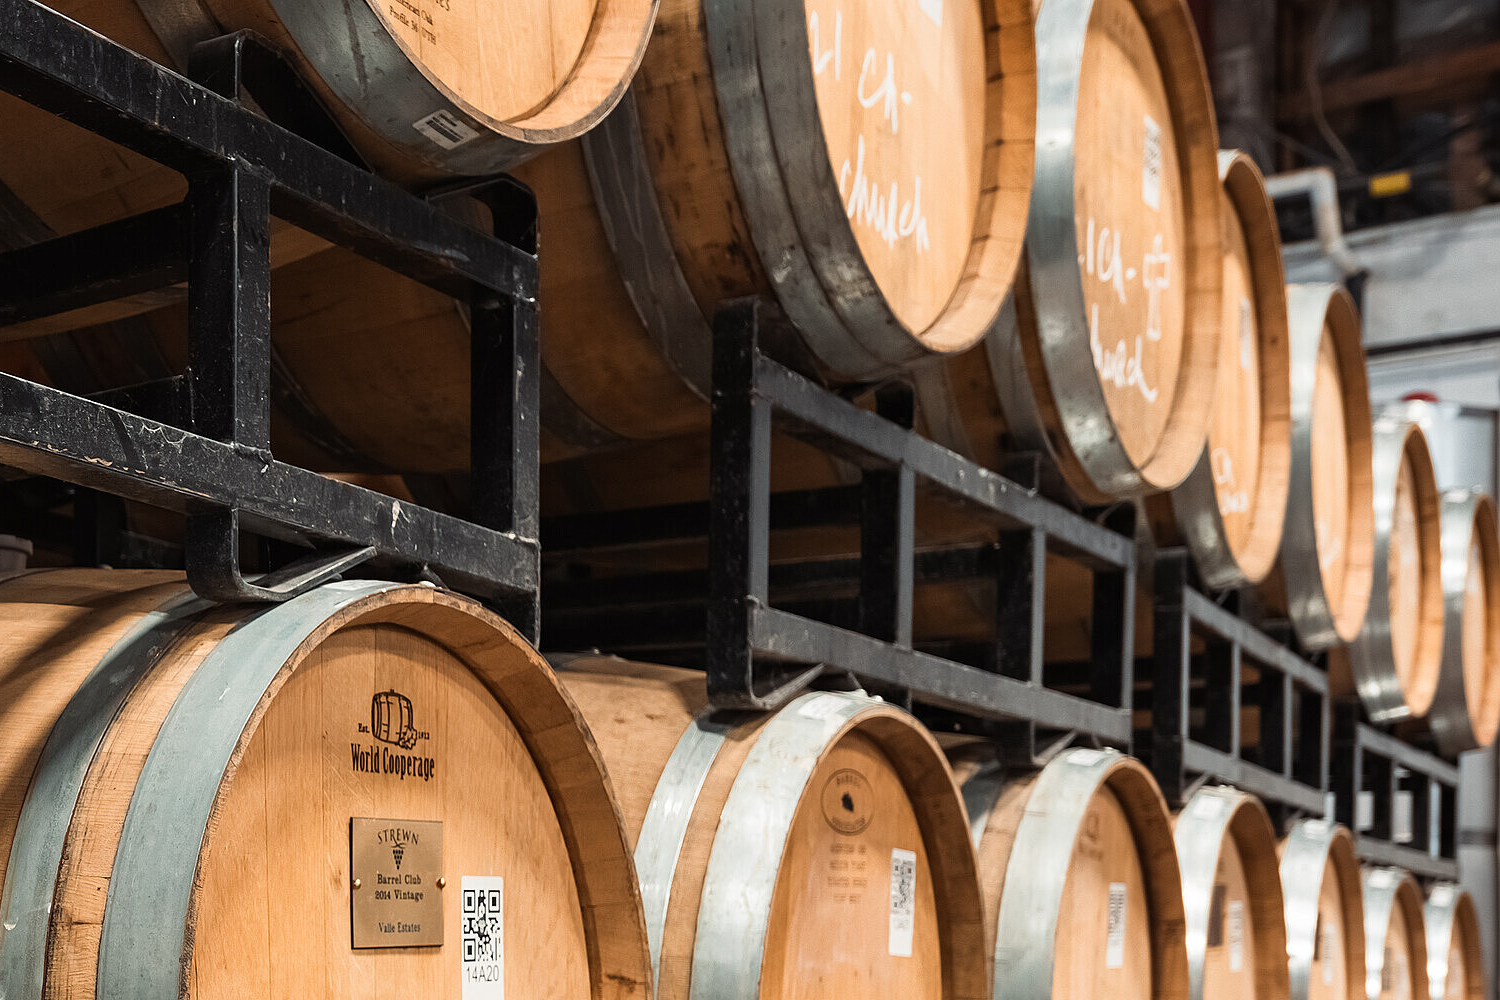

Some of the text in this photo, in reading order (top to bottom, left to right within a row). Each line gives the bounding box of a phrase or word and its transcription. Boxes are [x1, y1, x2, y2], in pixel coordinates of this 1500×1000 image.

[350, 743, 435, 782] World Cooperage
[377, 828, 419, 846] STREWN
[377, 873, 421, 885] Barrel Club
[374, 889, 423, 903] 2014 Vintage
[378, 921, 420, 933] Valle Estates
[466, 964, 499, 983] 14A20
